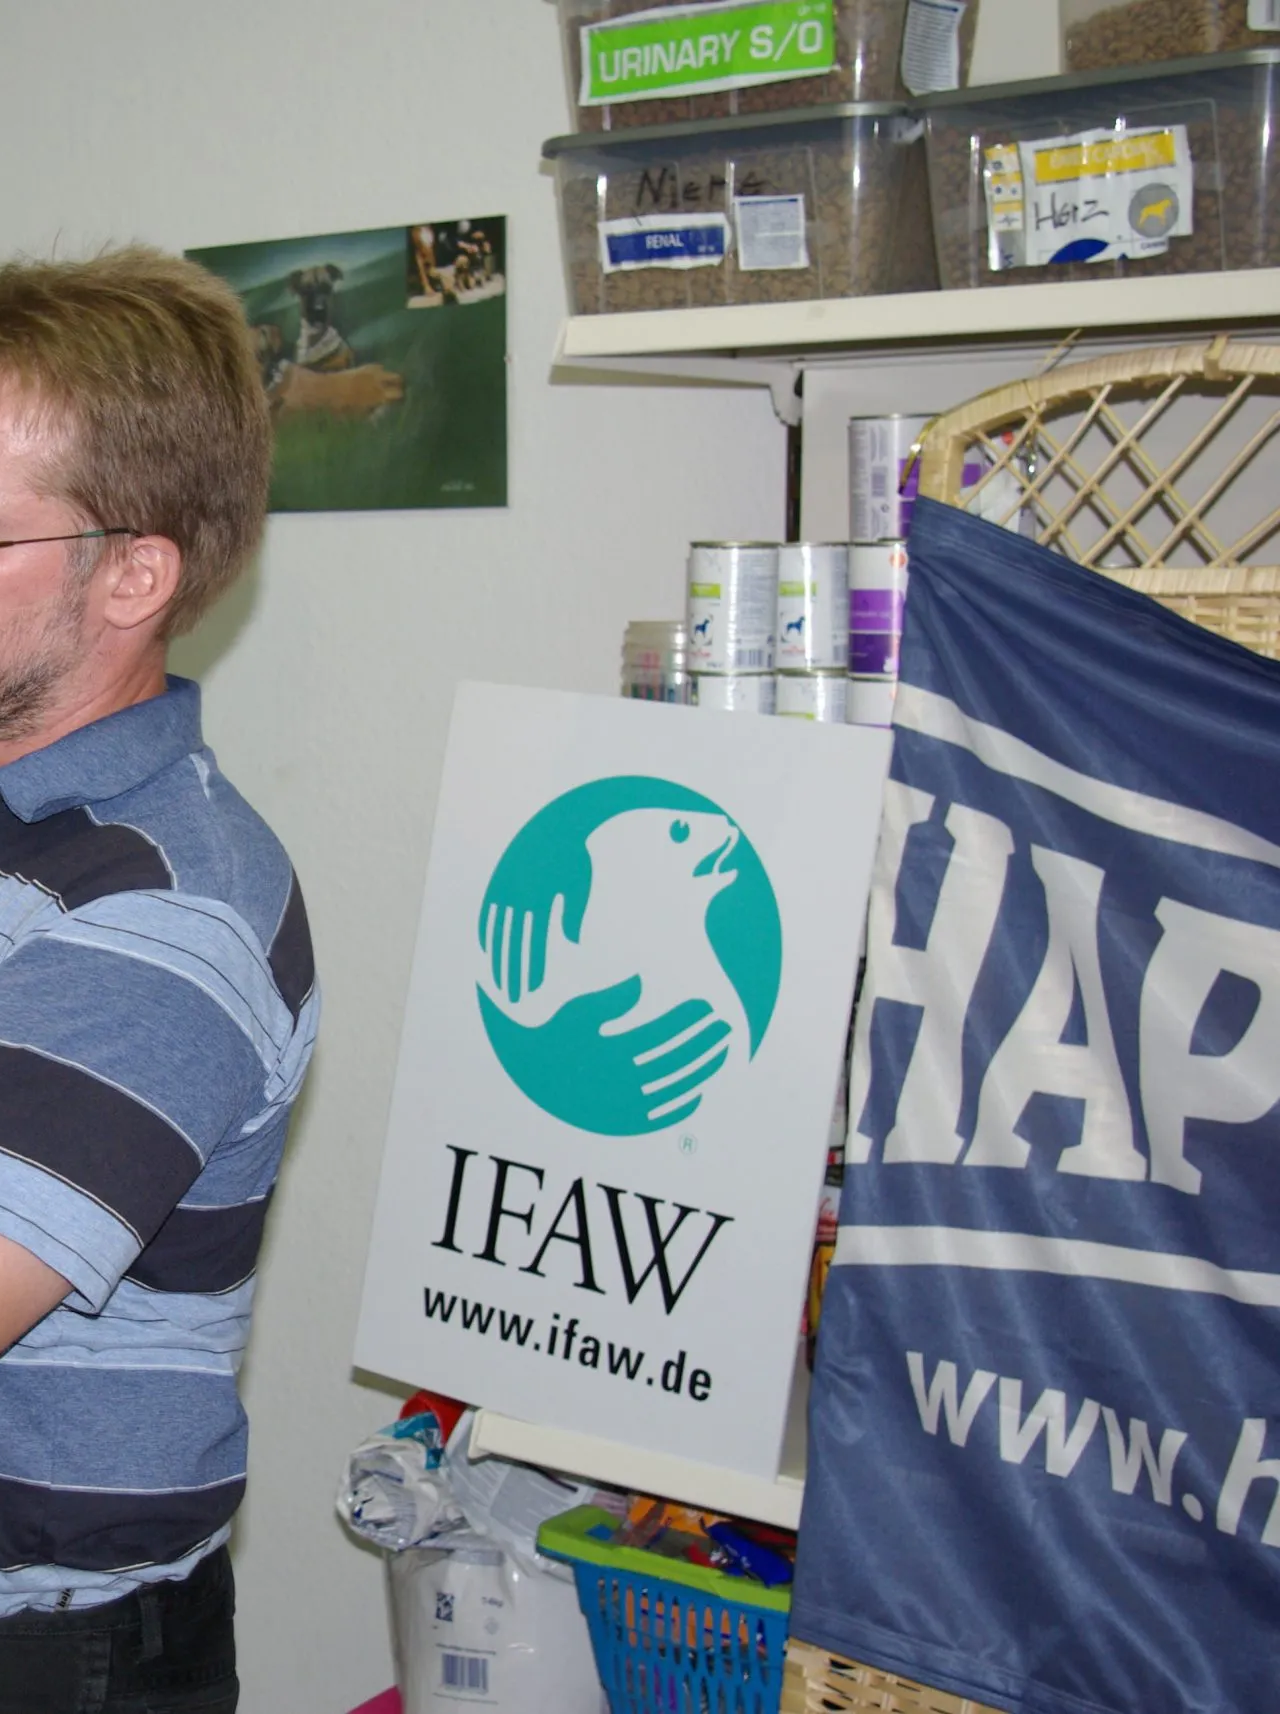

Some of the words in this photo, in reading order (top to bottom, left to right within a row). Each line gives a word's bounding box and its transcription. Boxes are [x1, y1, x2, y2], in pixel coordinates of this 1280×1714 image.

[599, 30, 740, 83] URINARY
[749, 20, 824, 63] S/O
[645, 233, 684, 249] RENAL
[845, 777, 1280, 1195] HAP
[430, 1144, 734, 1315] IFAW
[423, 1286, 712, 1402] www.ifaw.de
[906, 1351, 1280, 1548] www.h
